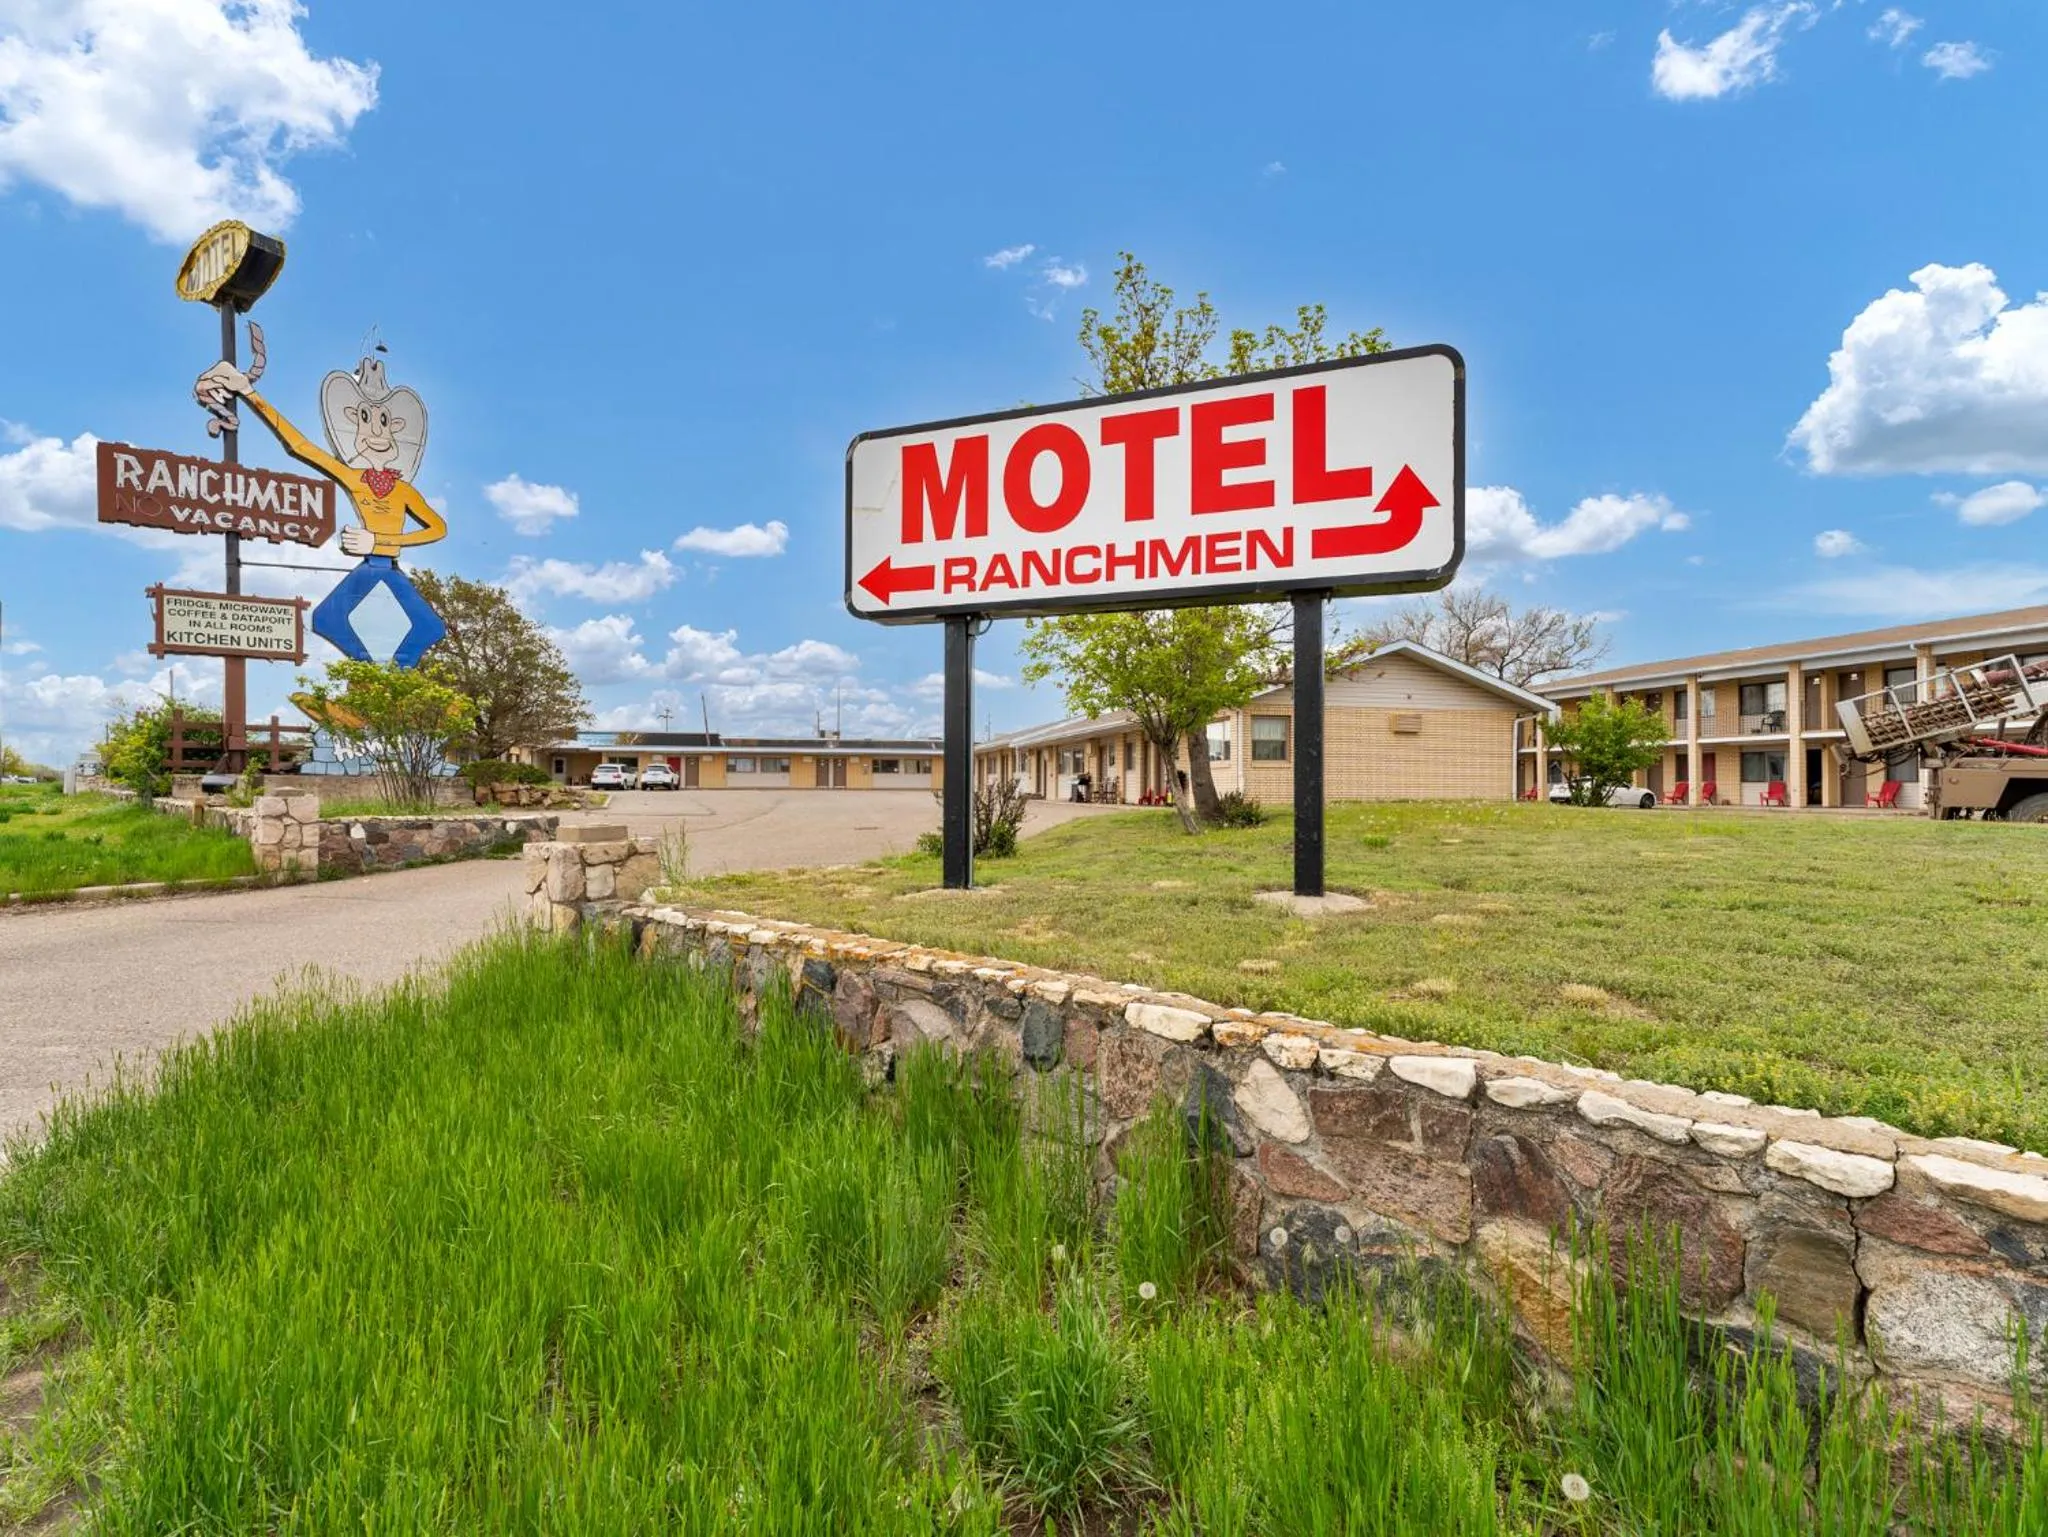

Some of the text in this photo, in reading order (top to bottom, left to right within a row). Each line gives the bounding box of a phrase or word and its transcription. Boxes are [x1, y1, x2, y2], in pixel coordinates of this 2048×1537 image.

[112, 451, 324, 520] RANCHMEN
[900, 384, 1373, 545] MOTEL
[115, 492, 320, 540] NO VACANCY
[943, 526, 1294, 595] RANCHMEN
[166, 630, 293, 650] KITCHEN UNITS
[167, 608, 293, 626] COFFEE & DATAPORT
[188, 619, 273, 633] IN ALL ROOMS
